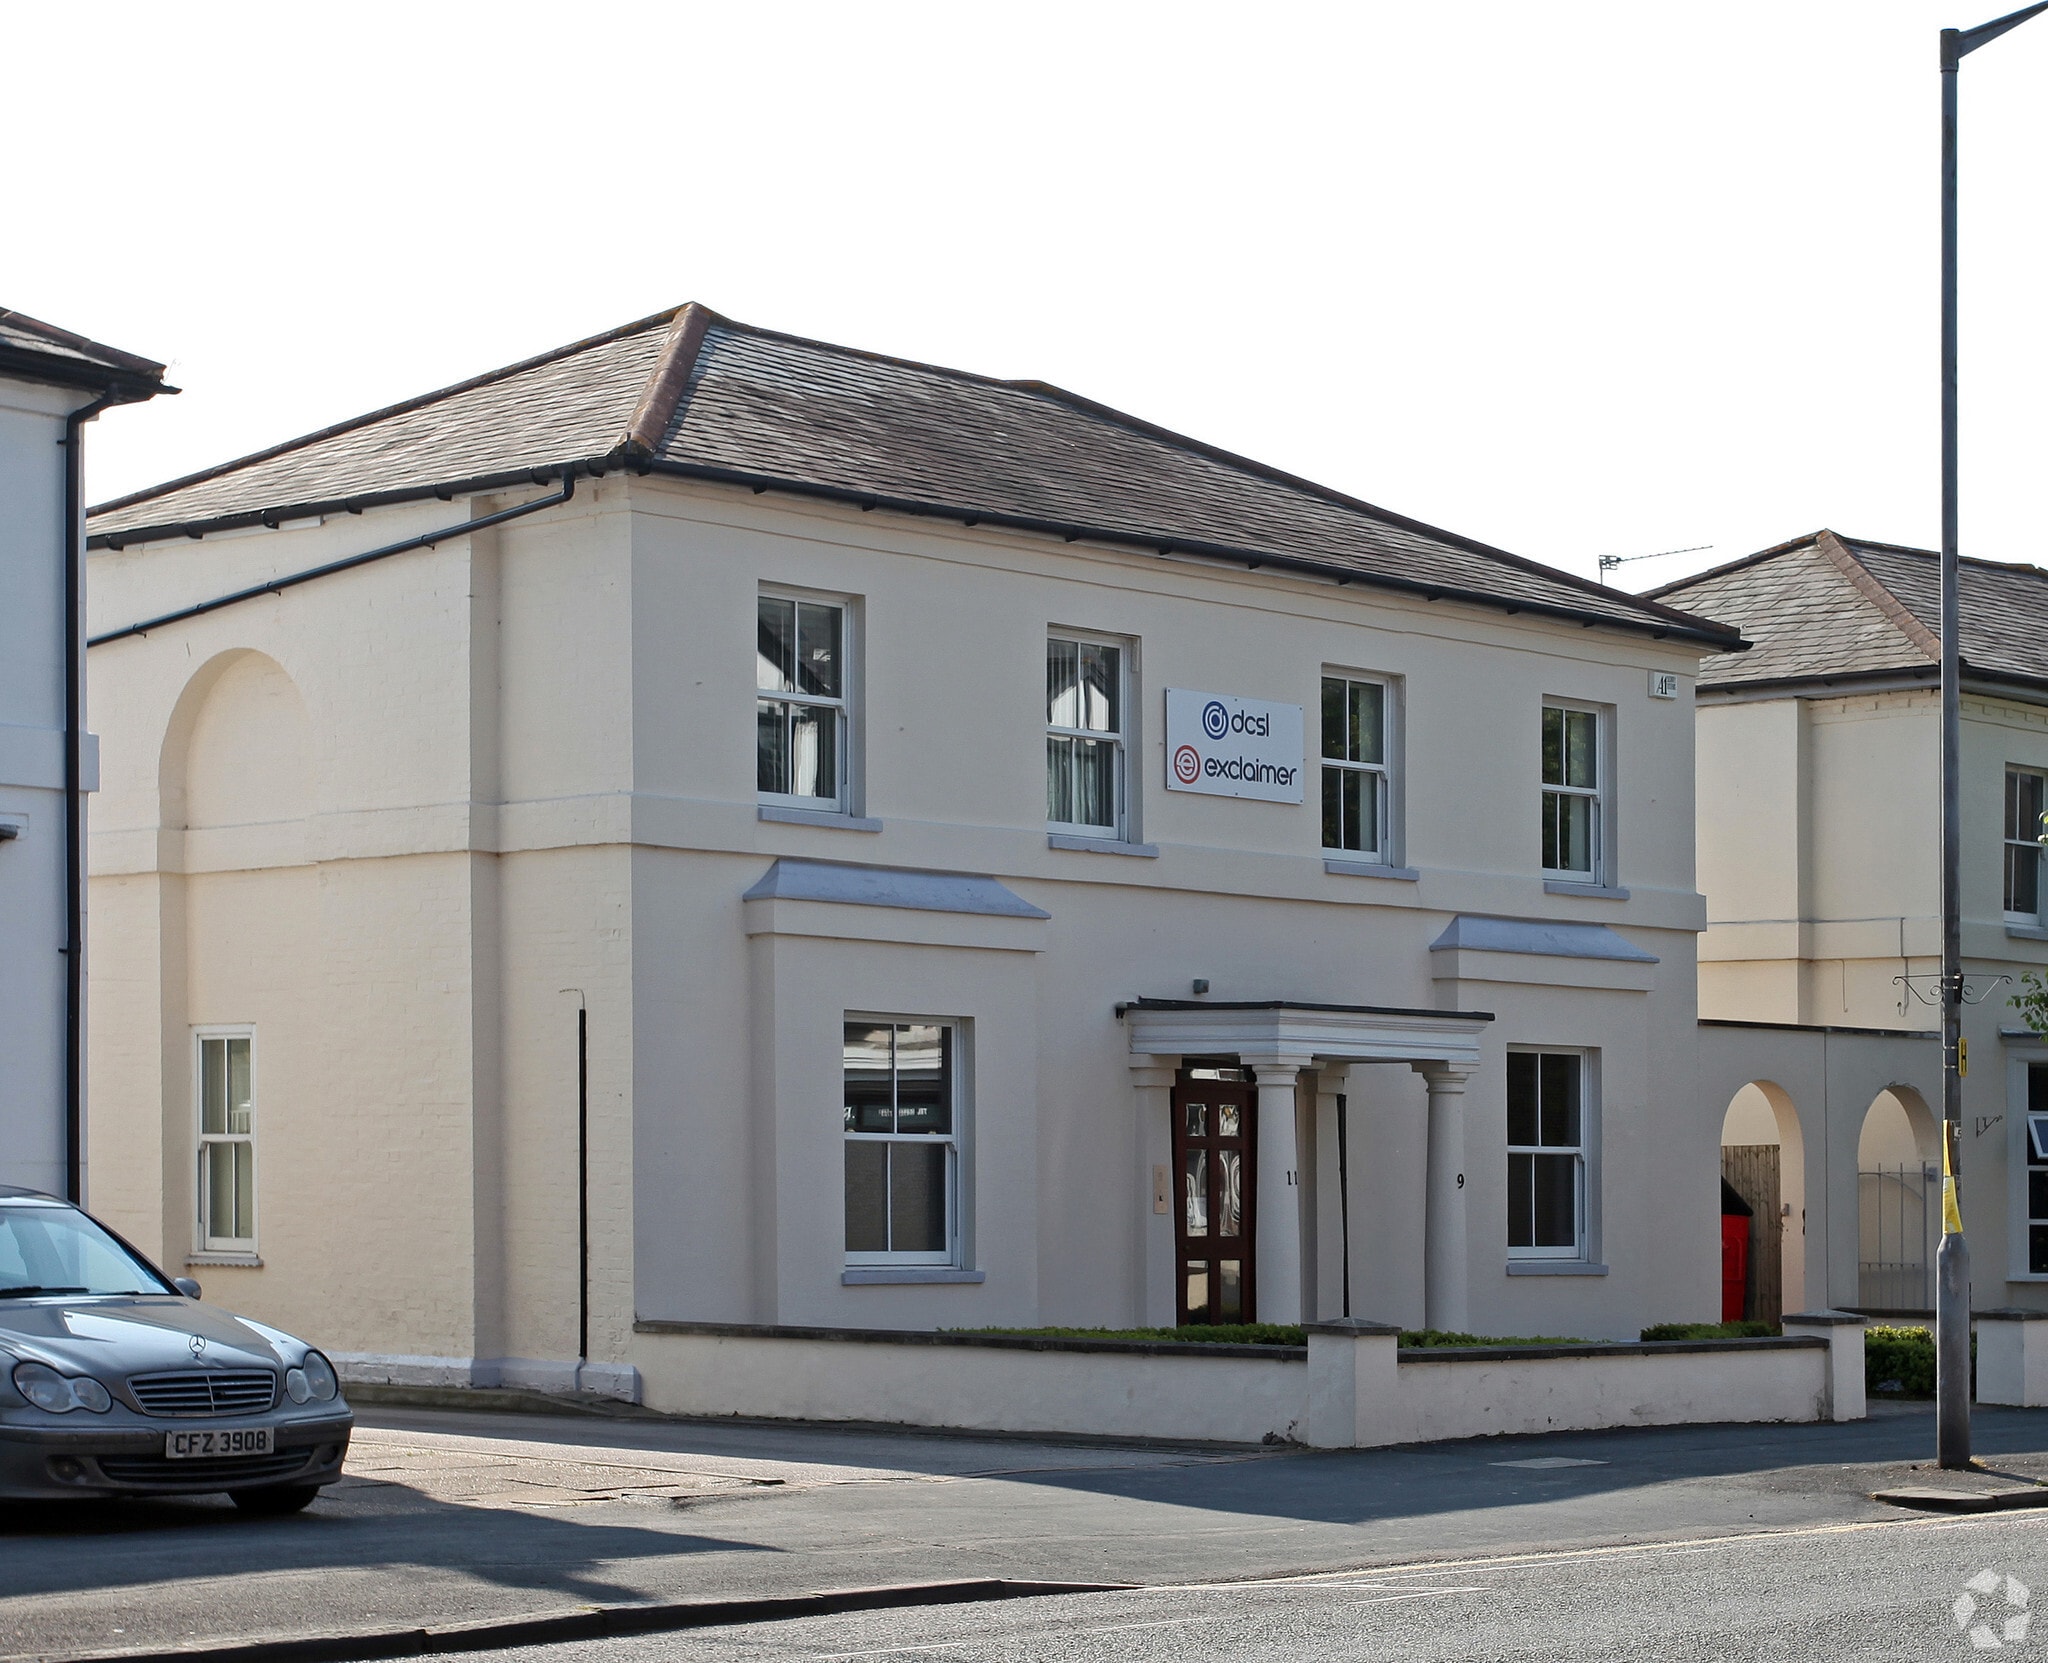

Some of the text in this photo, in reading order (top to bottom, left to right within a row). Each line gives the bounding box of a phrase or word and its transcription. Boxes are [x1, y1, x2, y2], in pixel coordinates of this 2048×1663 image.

[1231, 709, 1270, 737] dcsl
[1204, 756, 1298, 786] exclaimer
[1286, 1170, 1298, 1185] 11
[1457, 1173, 1465, 1189] 9
[175, 1430, 267, 1454] CFZ 3908
